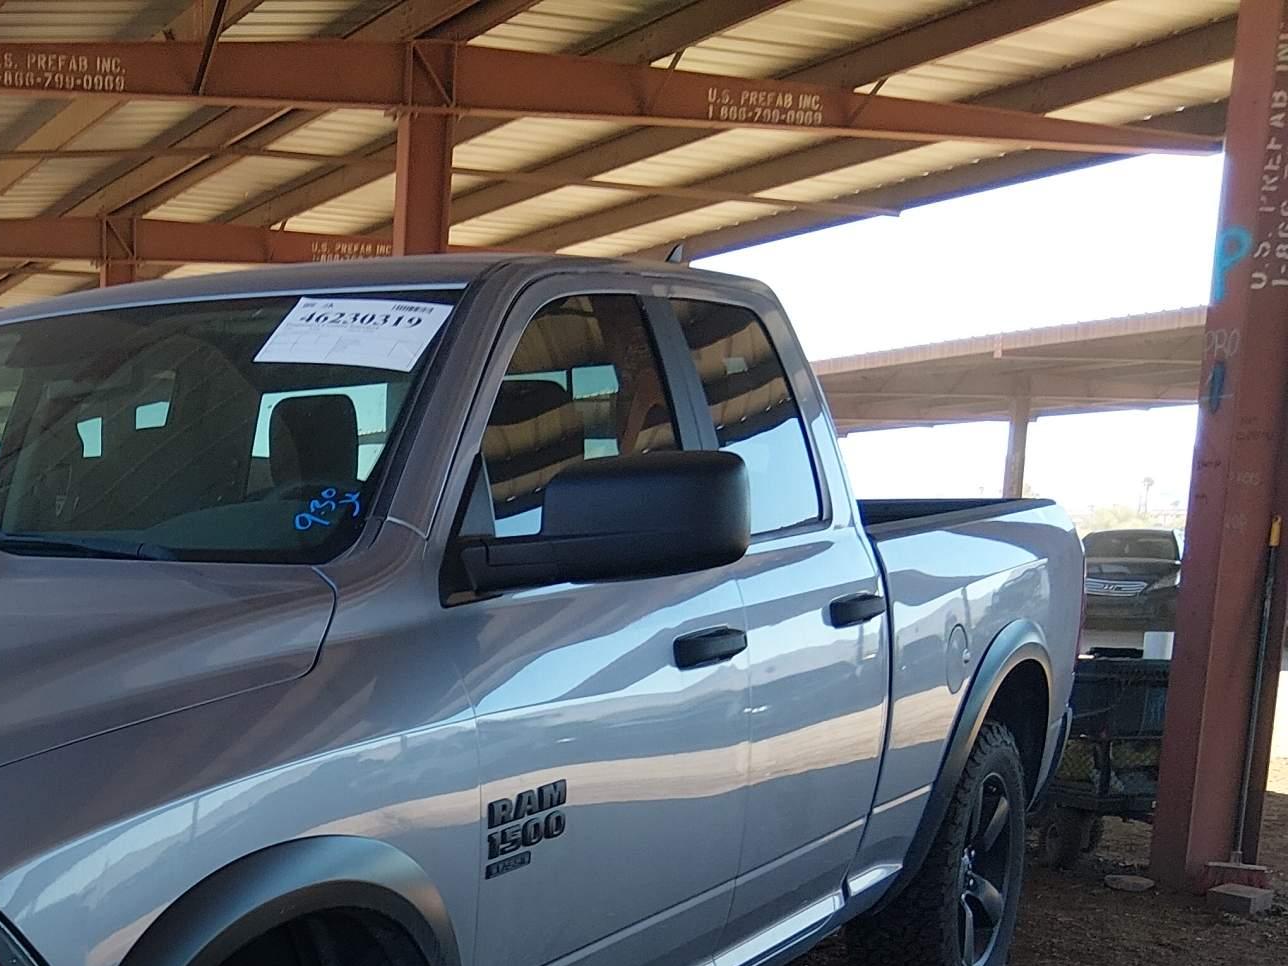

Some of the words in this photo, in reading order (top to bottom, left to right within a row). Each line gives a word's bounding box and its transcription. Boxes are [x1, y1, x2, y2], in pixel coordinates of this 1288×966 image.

[27, 53, 88, 71] PREFAB
[96, 56, 126, 74] INC.
[708, 87, 733, 104] U.S.
[741, 90, 793, 108] PREFAB
[300, 311, 423, 329] 46230319
[487, 779, 566, 829] RAM
[487, 810, 566, 860] 1500
